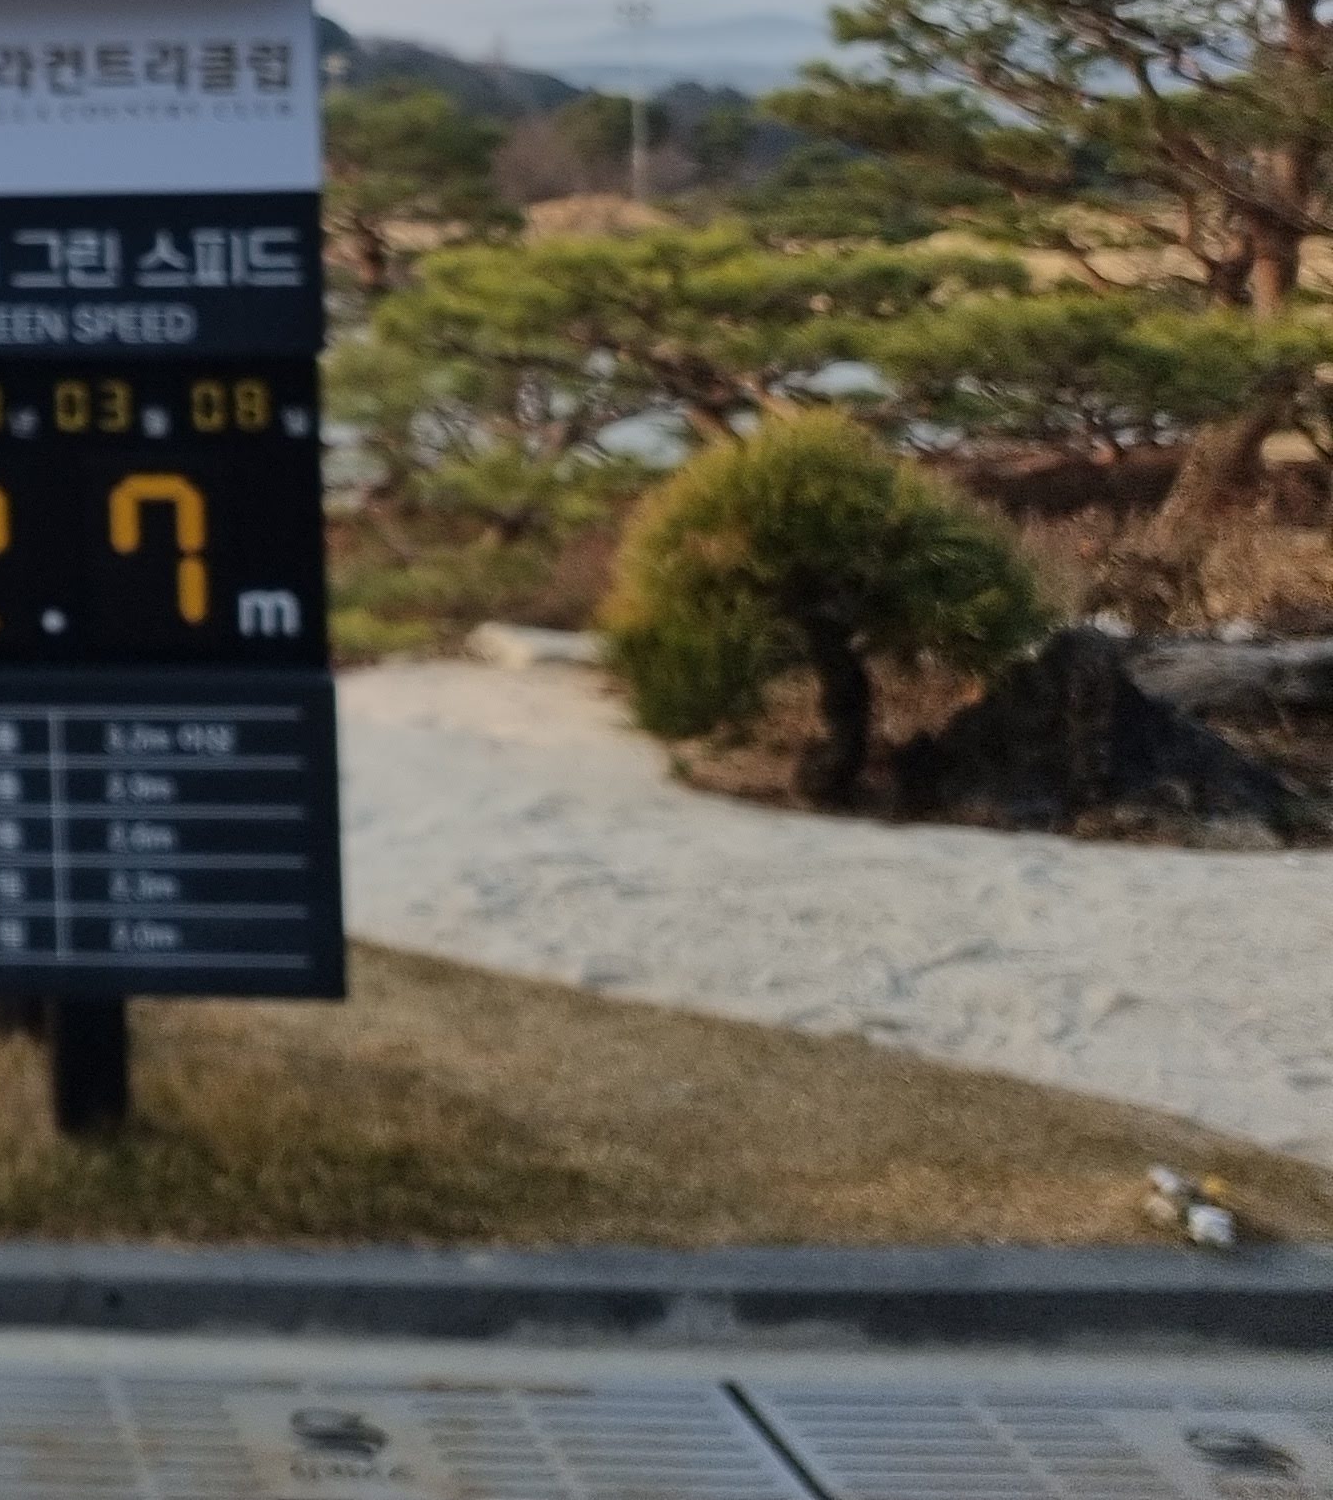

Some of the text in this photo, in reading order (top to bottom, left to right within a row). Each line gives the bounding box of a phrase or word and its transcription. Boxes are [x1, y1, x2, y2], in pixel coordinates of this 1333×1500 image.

[9, 229, 123, 289] 그린
[136, 227, 304, 287] 스피드
[72, 303, 197, 343] SPEED
